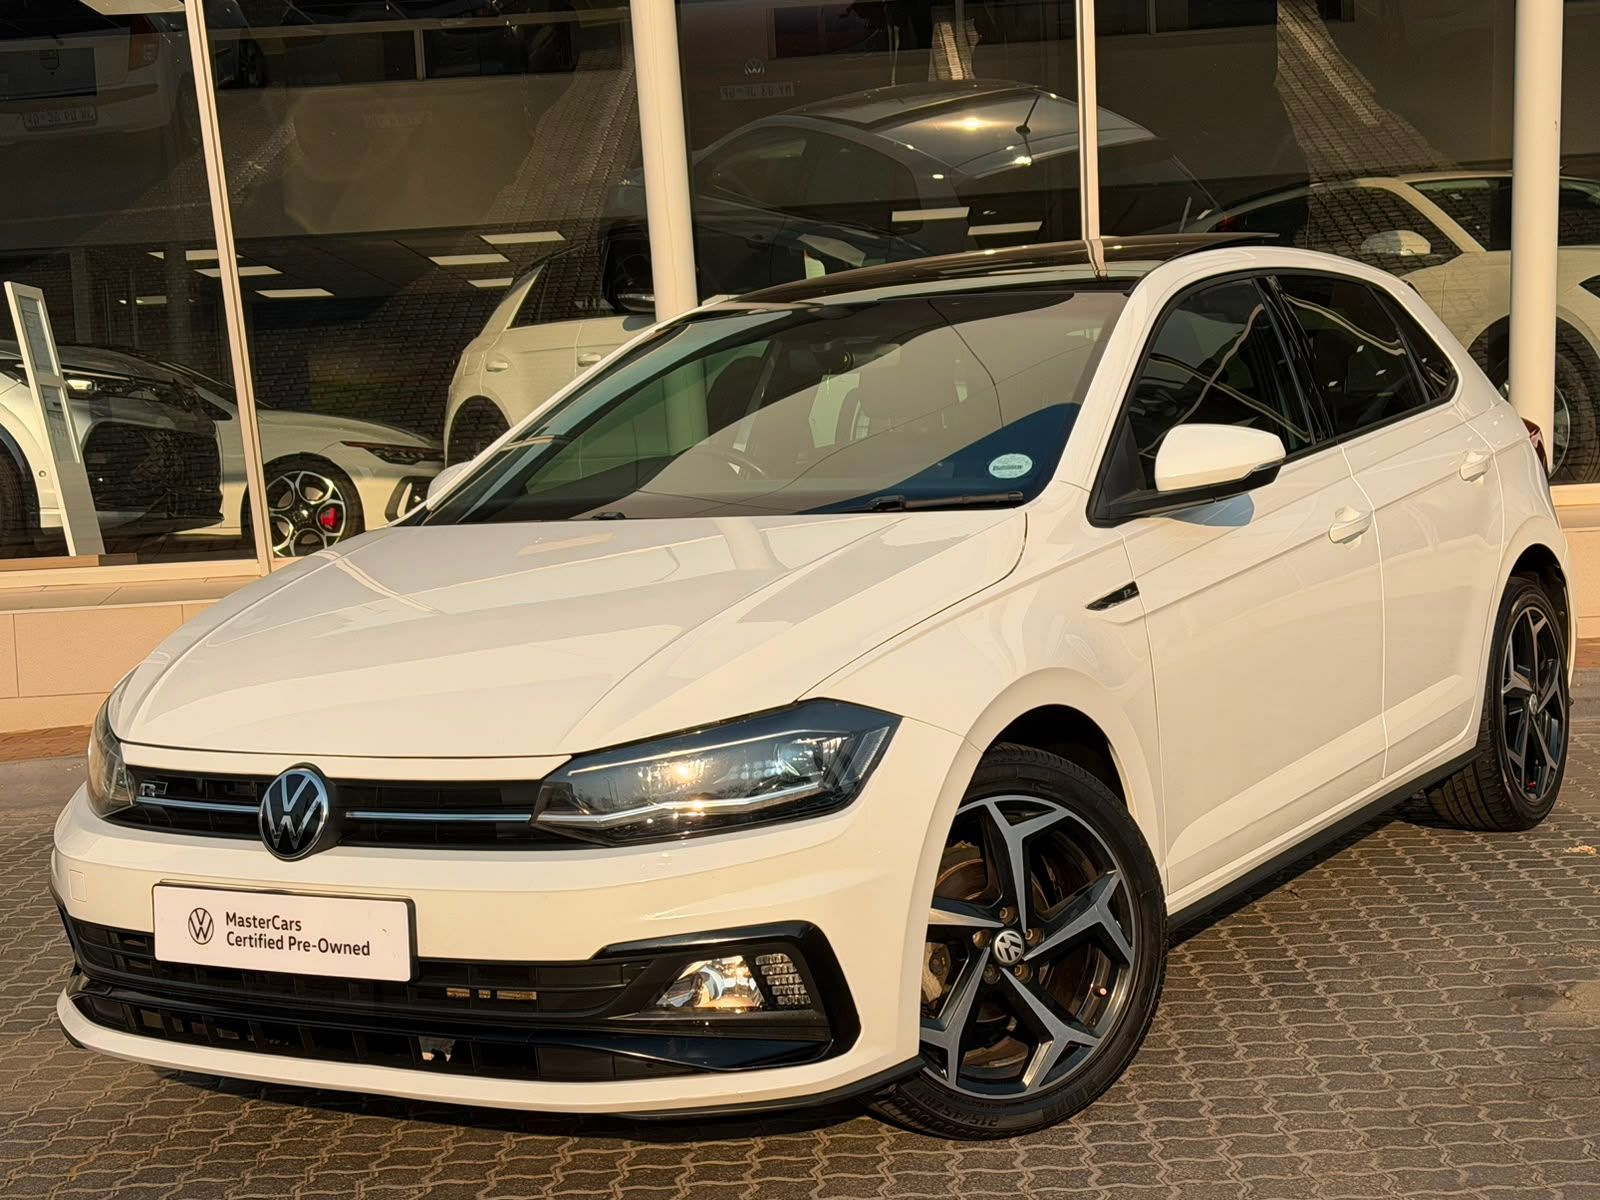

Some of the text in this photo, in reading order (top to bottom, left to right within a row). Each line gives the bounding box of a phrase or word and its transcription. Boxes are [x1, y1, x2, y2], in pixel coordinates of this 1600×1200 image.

[260, 769, 328, 858] VW
[188, 908, 214, 945] VW
[225, 911, 302, 932] MasterCars
[226, 931, 370, 956] Certified Pre-Owned
